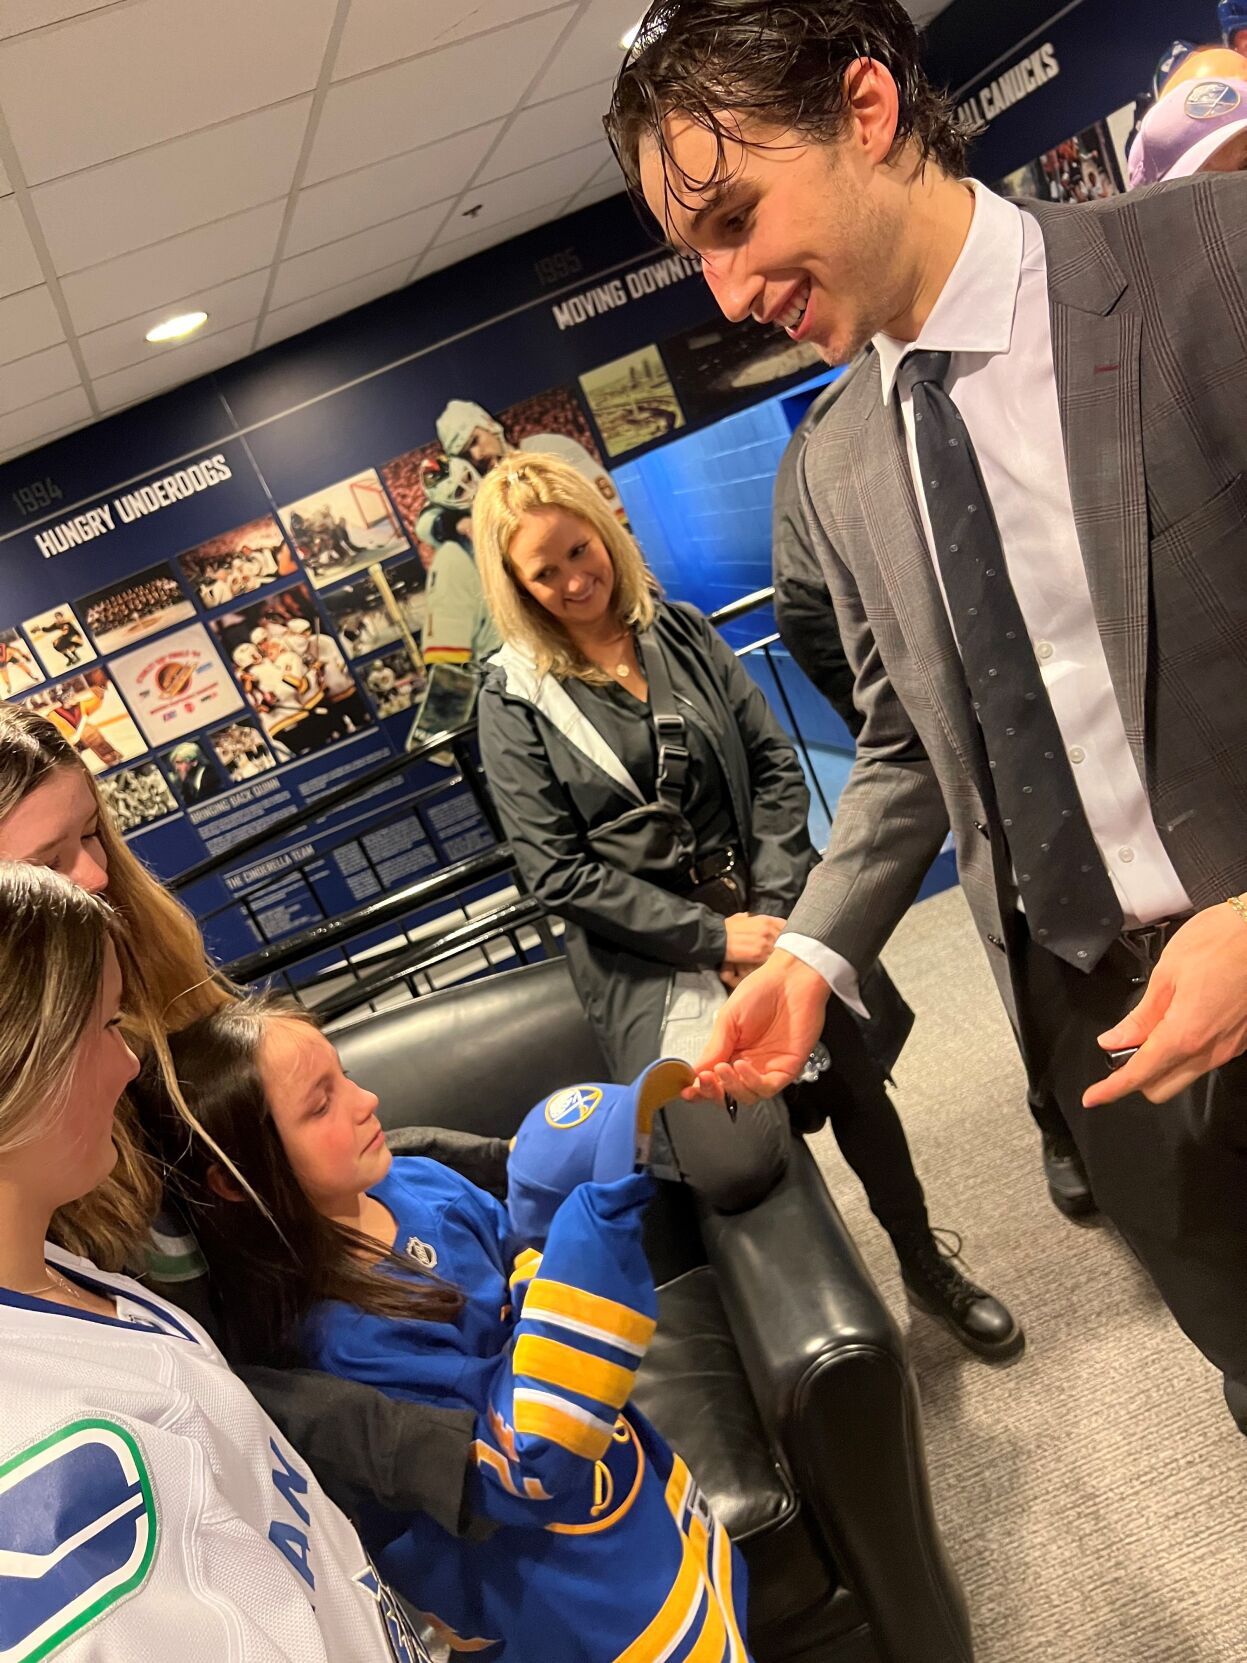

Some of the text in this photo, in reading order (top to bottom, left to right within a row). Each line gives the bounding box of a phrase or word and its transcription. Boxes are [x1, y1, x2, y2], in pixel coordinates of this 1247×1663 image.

[978, 42, 1060, 120] CANUCKS
[552, 280, 628, 330] MOVING
[11, 476, 64, 516] 1994
[34, 453, 233, 559] HUNGRY UNDERDOGS
[189, 798, 232, 825] BRINGING
[229, 789, 255, 808] BACK
[224, 843, 316, 891] THE CINDERELLA TEAM
